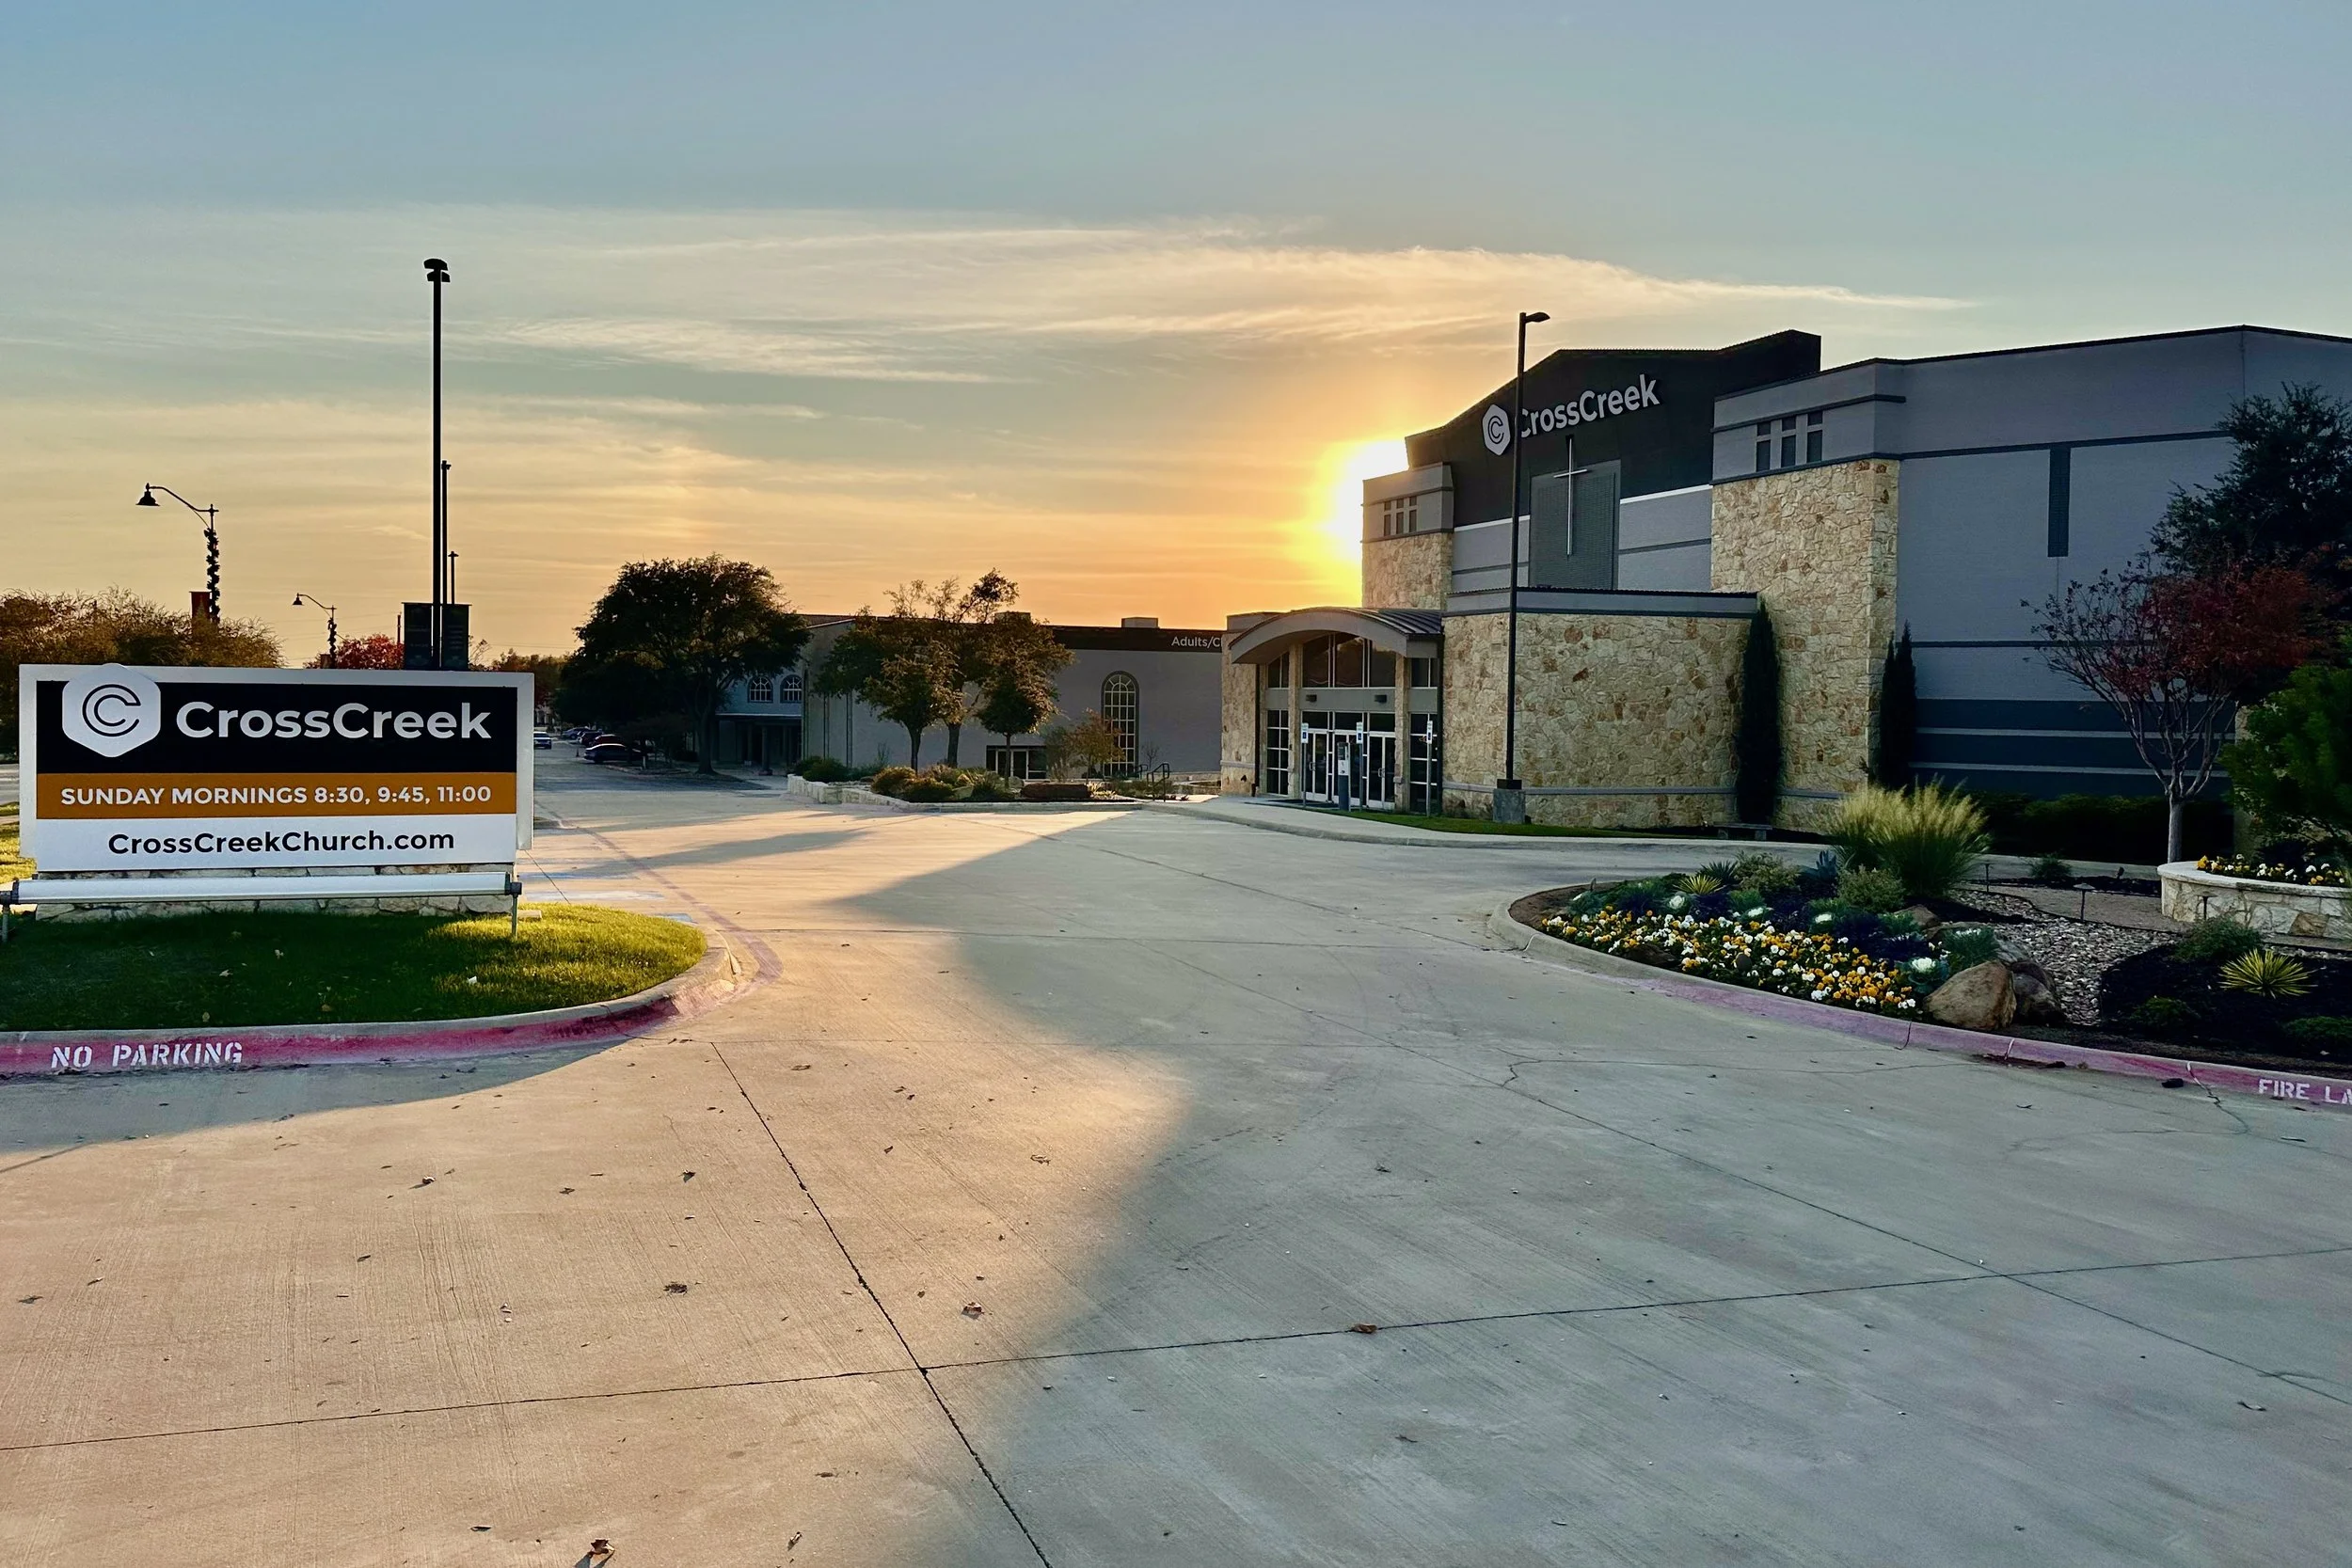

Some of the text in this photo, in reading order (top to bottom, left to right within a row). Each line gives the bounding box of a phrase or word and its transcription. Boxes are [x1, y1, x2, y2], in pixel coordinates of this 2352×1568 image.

[1170, 636, 1223, 649] Adults/C
[176, 701, 492, 739] CrossCreek
[60, 785, 492, 806] SUNDAY MORNINGS 8:30, 9:45, 11:00
[108, 830, 455, 855] CrossCreekChurch.com
[51, 1041, 244, 1069] NO PARKING
[2258, 1078, 2311, 1101] FIRE
